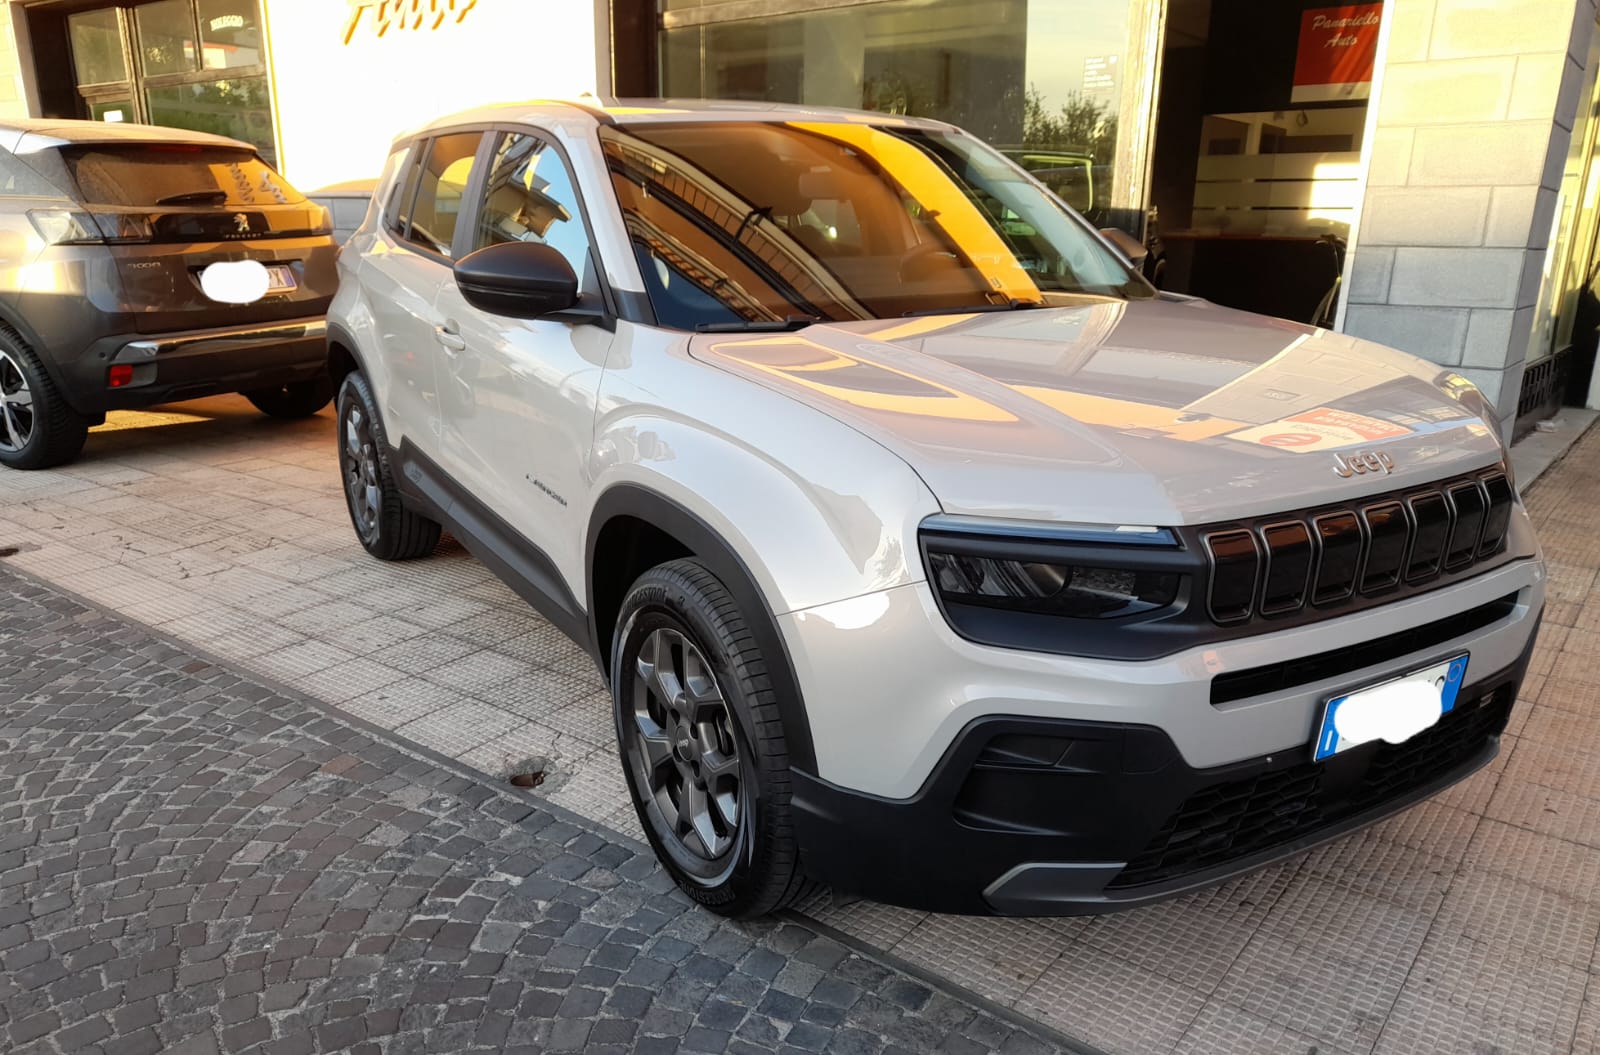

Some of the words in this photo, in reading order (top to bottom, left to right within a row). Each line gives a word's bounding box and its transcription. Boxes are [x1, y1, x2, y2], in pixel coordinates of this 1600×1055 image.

[1311, 11, 1380, 31] Panariello
[1323, 32, 1358, 48] Auto
[1332, 451, 1395, 478] Jeep
